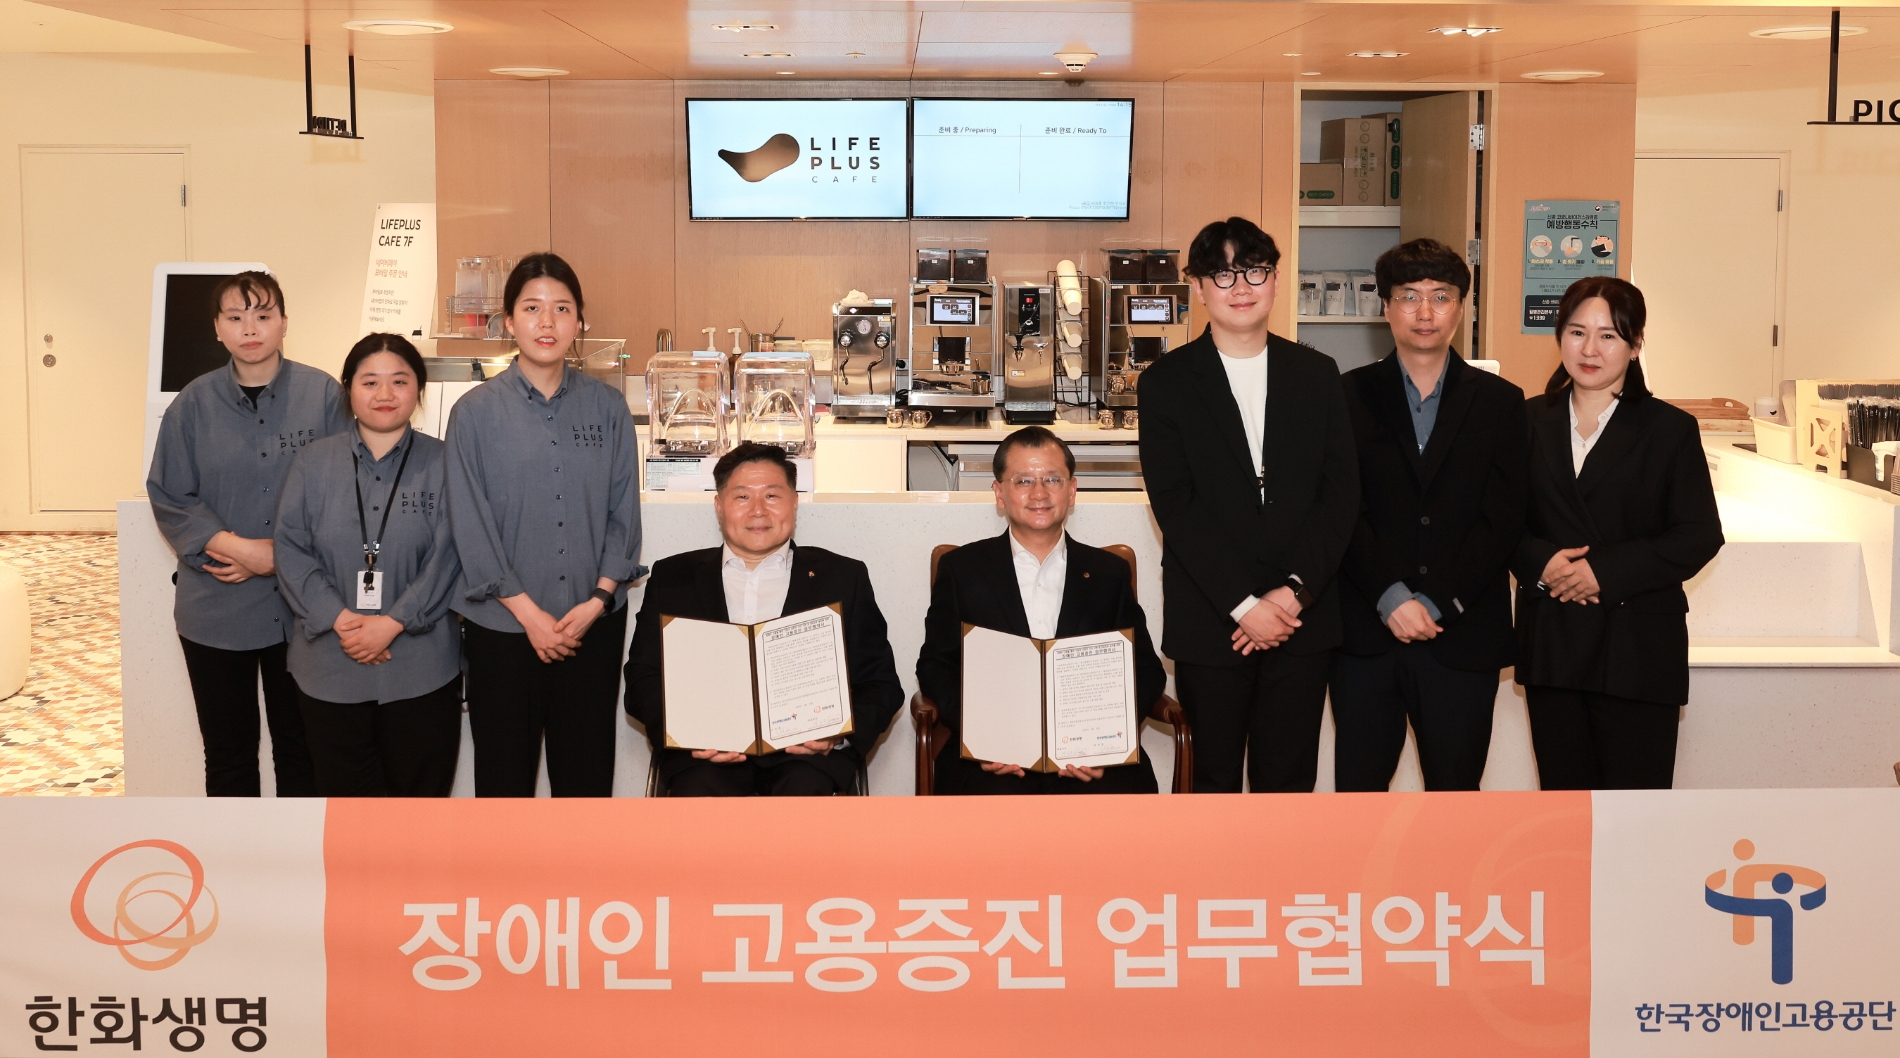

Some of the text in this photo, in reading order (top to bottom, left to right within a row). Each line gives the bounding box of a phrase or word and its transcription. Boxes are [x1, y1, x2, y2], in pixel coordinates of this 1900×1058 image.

[938, 126, 951, 134] 준비
[1044, 126, 1058, 134] 준비
[810, 137, 881, 151] LIFE
[810, 156, 881, 170] PLUS
[811, 175, 878, 183] CAFE
[380, 219, 421, 230] LIFEPLUS
[1546, 219, 1598, 230] 예방행동수칙
[378, 235, 414, 247] CAFE 7F
[572, 424, 602, 432] LIFE
[279, 429, 314, 440] LIFE
[402, 491, 435, 500] LIFE
[402, 501, 434, 510] PLUS
[398, 890, 1546, 993] 장애인 고용증진 업무협약식
[1634, 1000, 1897, 1033] 한국장애인고용공단
[25, 995, 268, 1053] 한화생명
